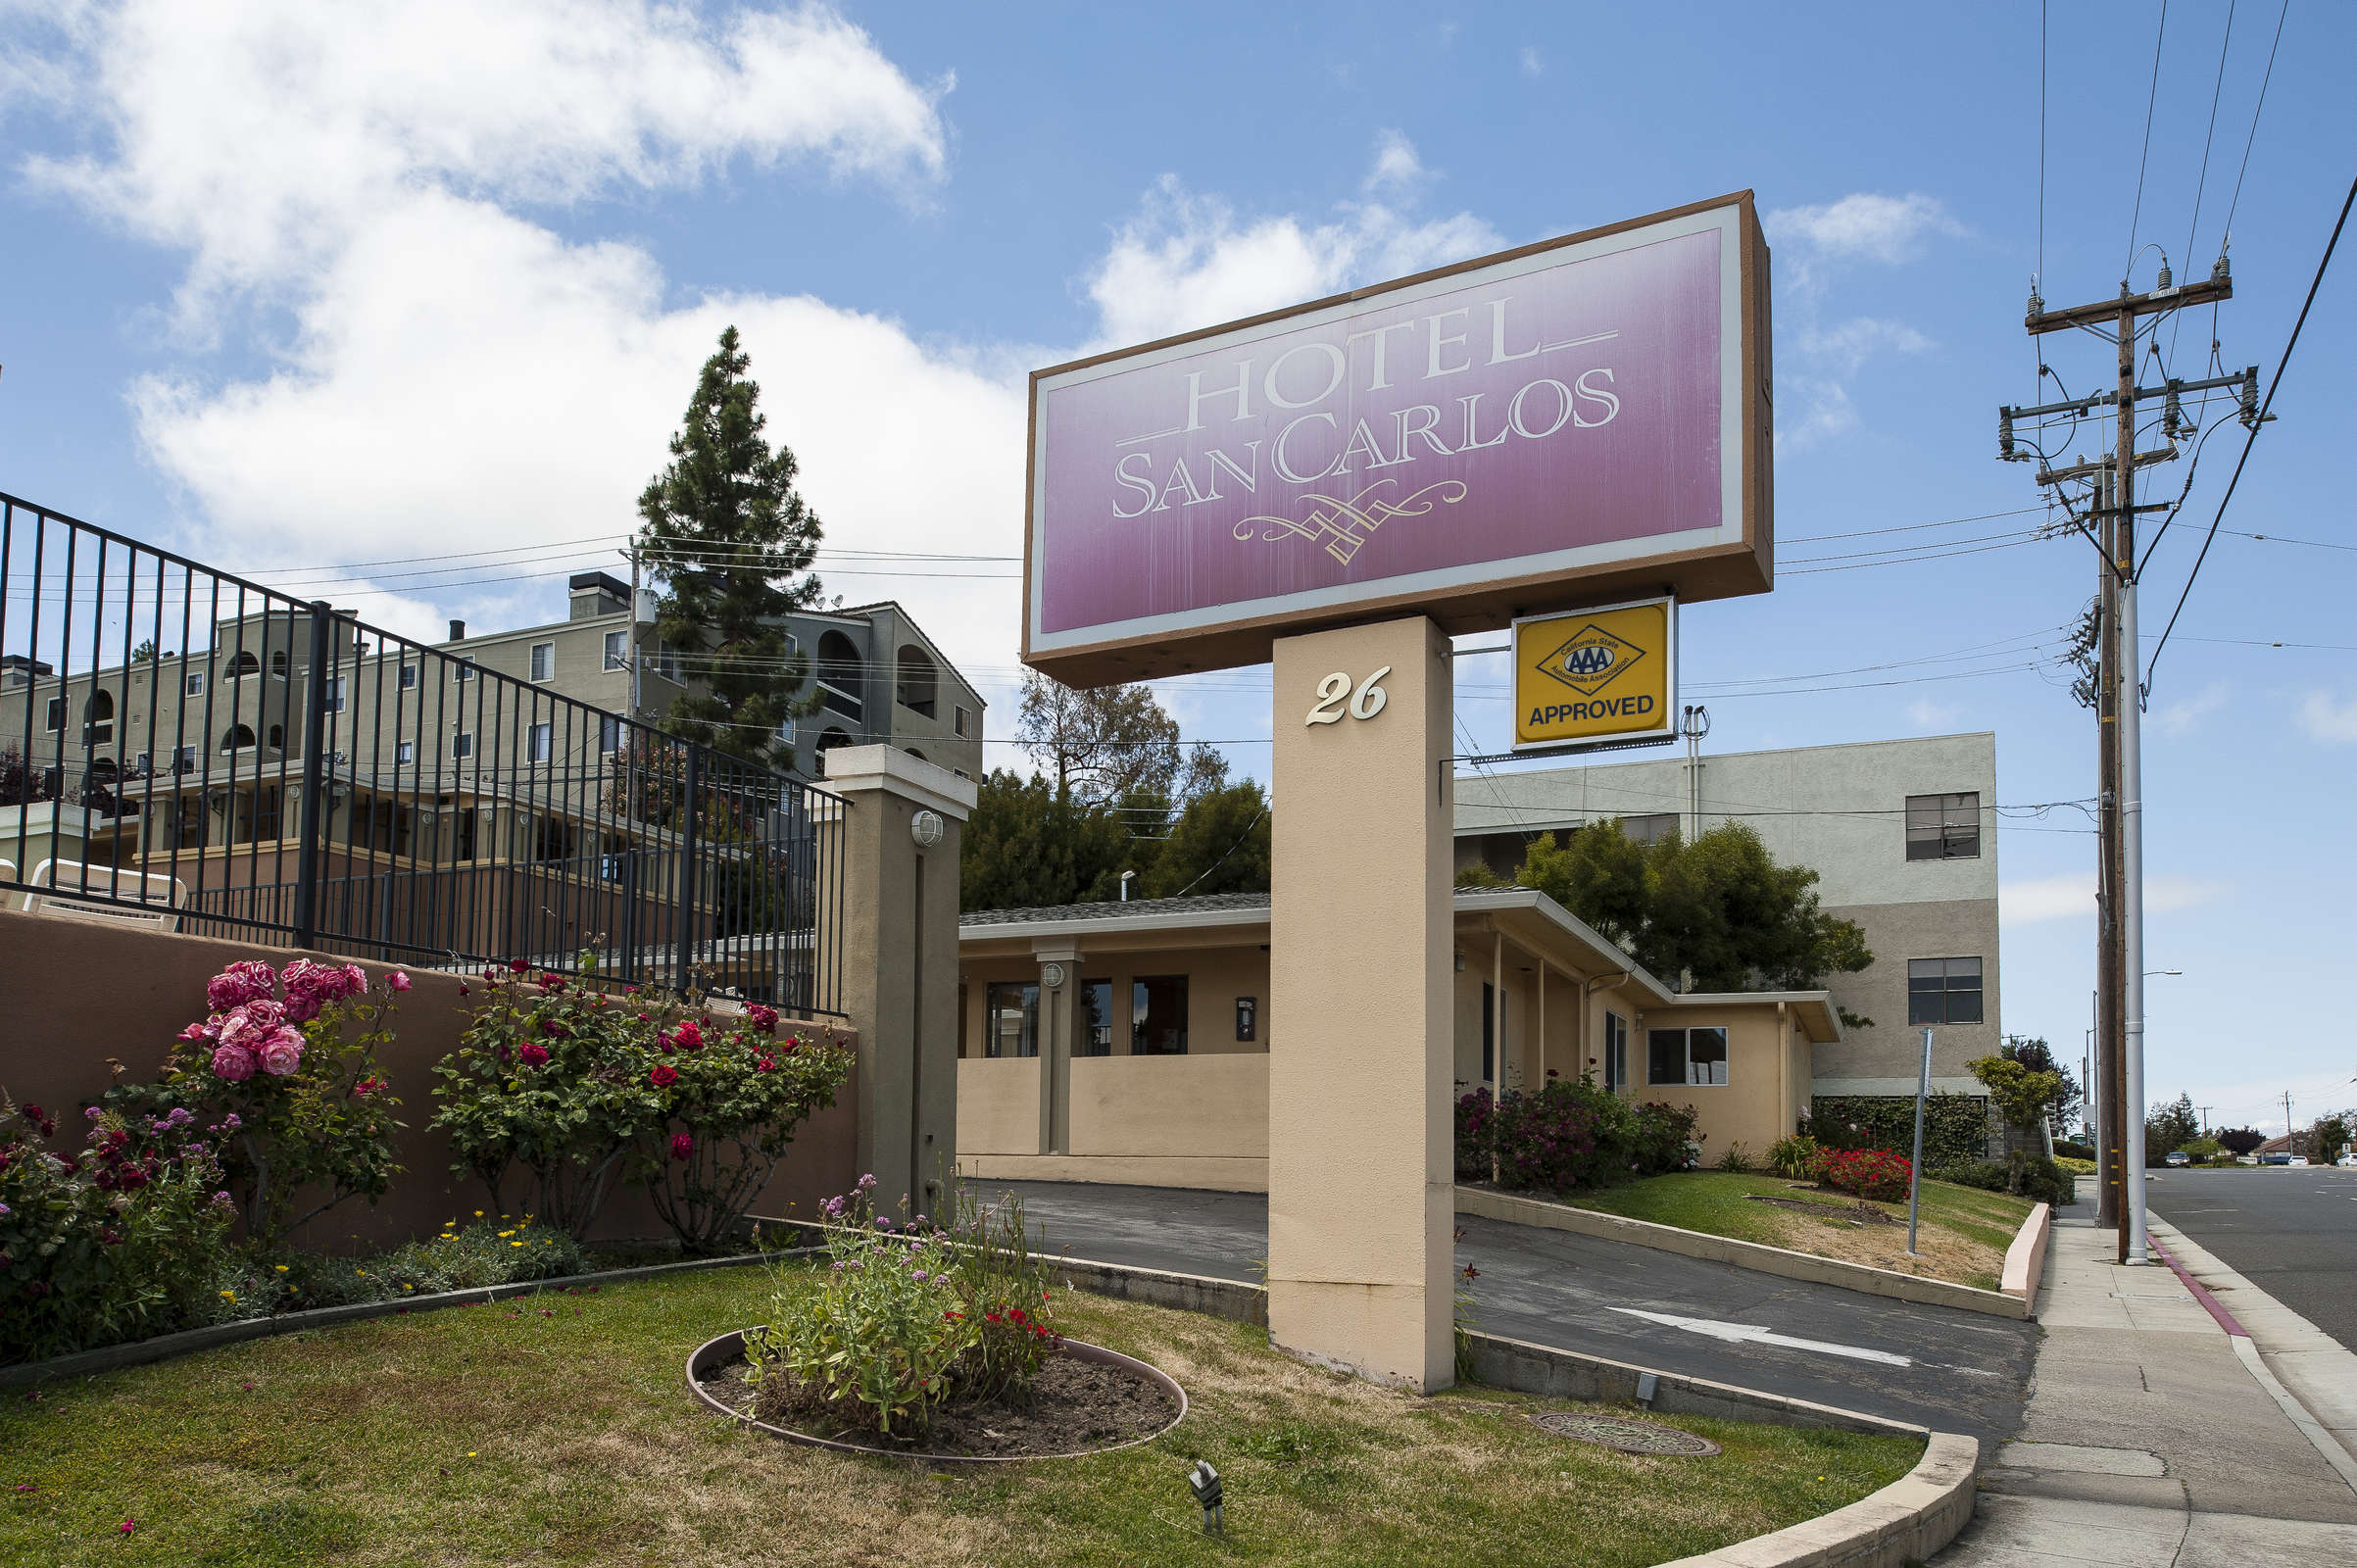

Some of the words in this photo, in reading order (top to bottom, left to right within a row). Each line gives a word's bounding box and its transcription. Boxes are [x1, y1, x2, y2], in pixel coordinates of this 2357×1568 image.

[1182, 297, 1541, 433] HOTEL
[1113, 440, 1262, 517] SAN
[1271, 368, 1620, 483] CARLOS
[1560, 638, 1597, 656] California
[1599, 638, 1619, 649] State
[1568, 647, 1609, 674] AAA
[1550, 665, 1588, 683] Automobile
[1590, 658, 1630, 682] Association
[1305, 665, 1392, 726] 26
[1529, 695, 1654, 726] APPROVED
